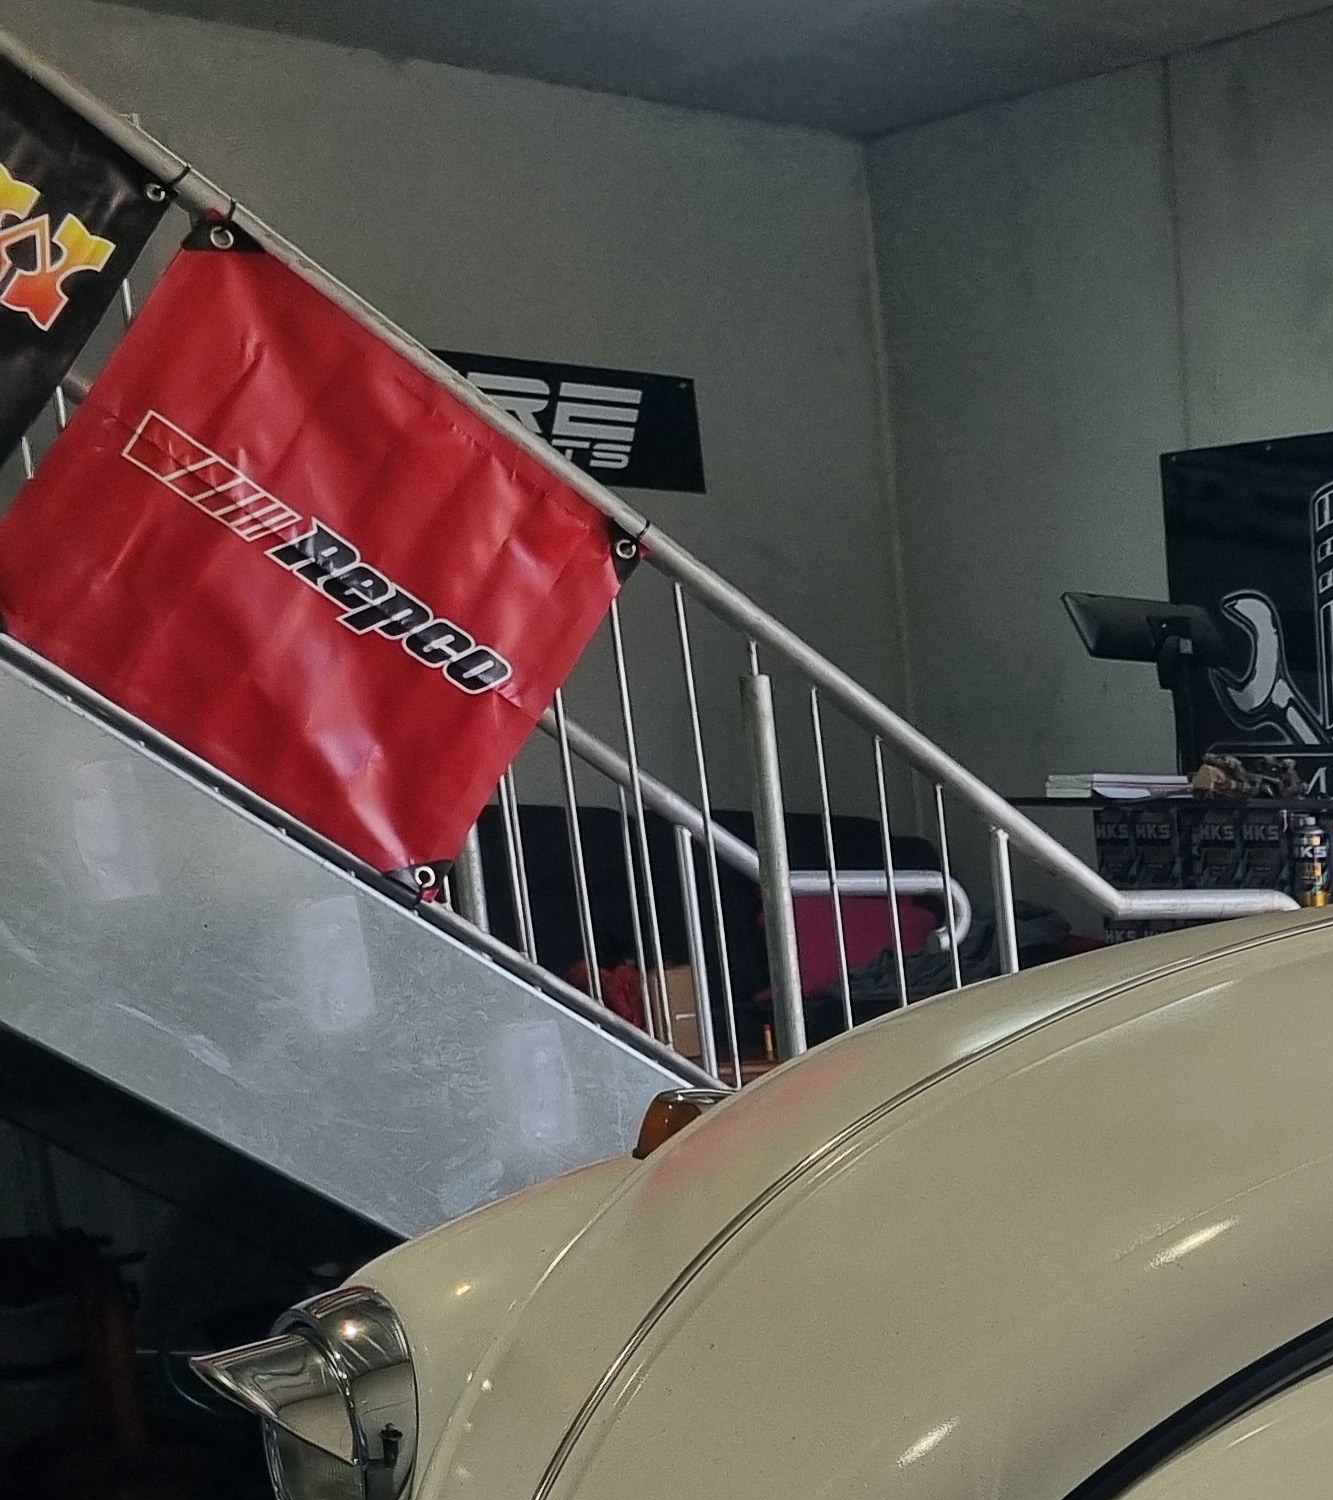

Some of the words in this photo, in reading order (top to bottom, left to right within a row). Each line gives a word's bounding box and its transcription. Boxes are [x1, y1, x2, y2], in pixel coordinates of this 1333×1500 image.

[264, 516, 511, 694] Repco
[1134, 824, 1171, 840] HKS
[1241, 825, 1280, 842] HKS
